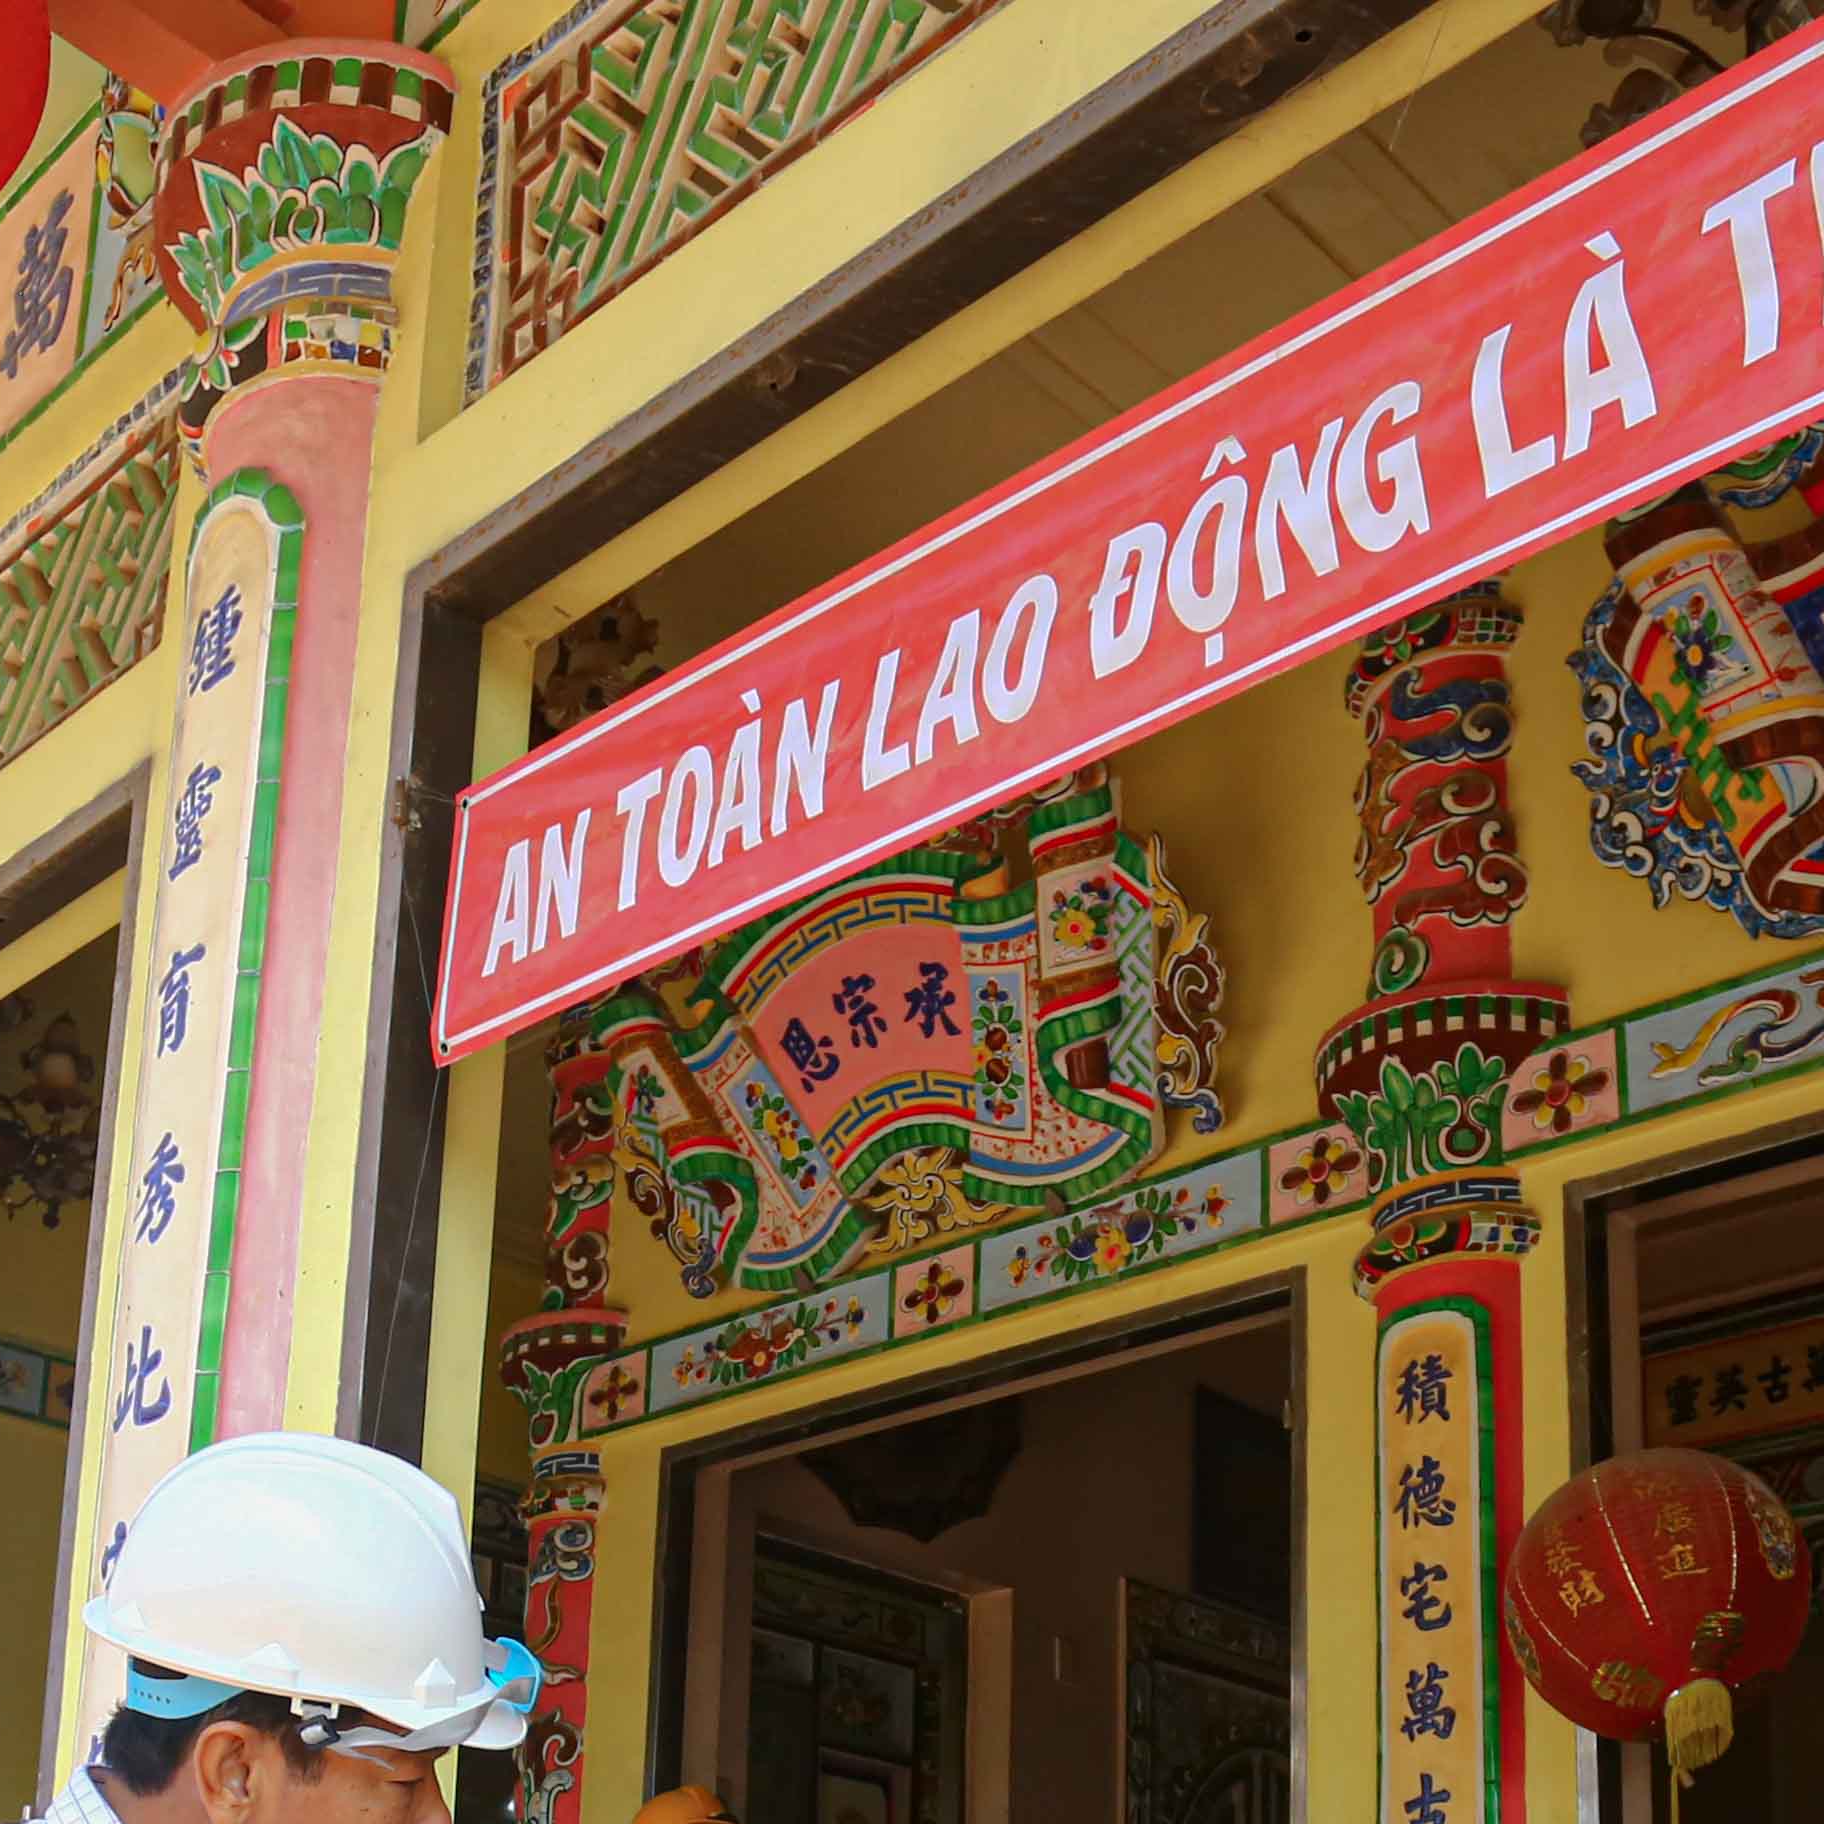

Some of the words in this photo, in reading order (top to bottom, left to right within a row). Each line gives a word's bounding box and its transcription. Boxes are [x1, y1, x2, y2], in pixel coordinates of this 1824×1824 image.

[482, 806, 589, 977] AN
[616, 679, 840, 910] TOÀN
[862, 574, 1056, 791] LAO
[1090, 380, 1430, 680] ĐỘNG
[1472, 231, 1657, 498] LÀ
